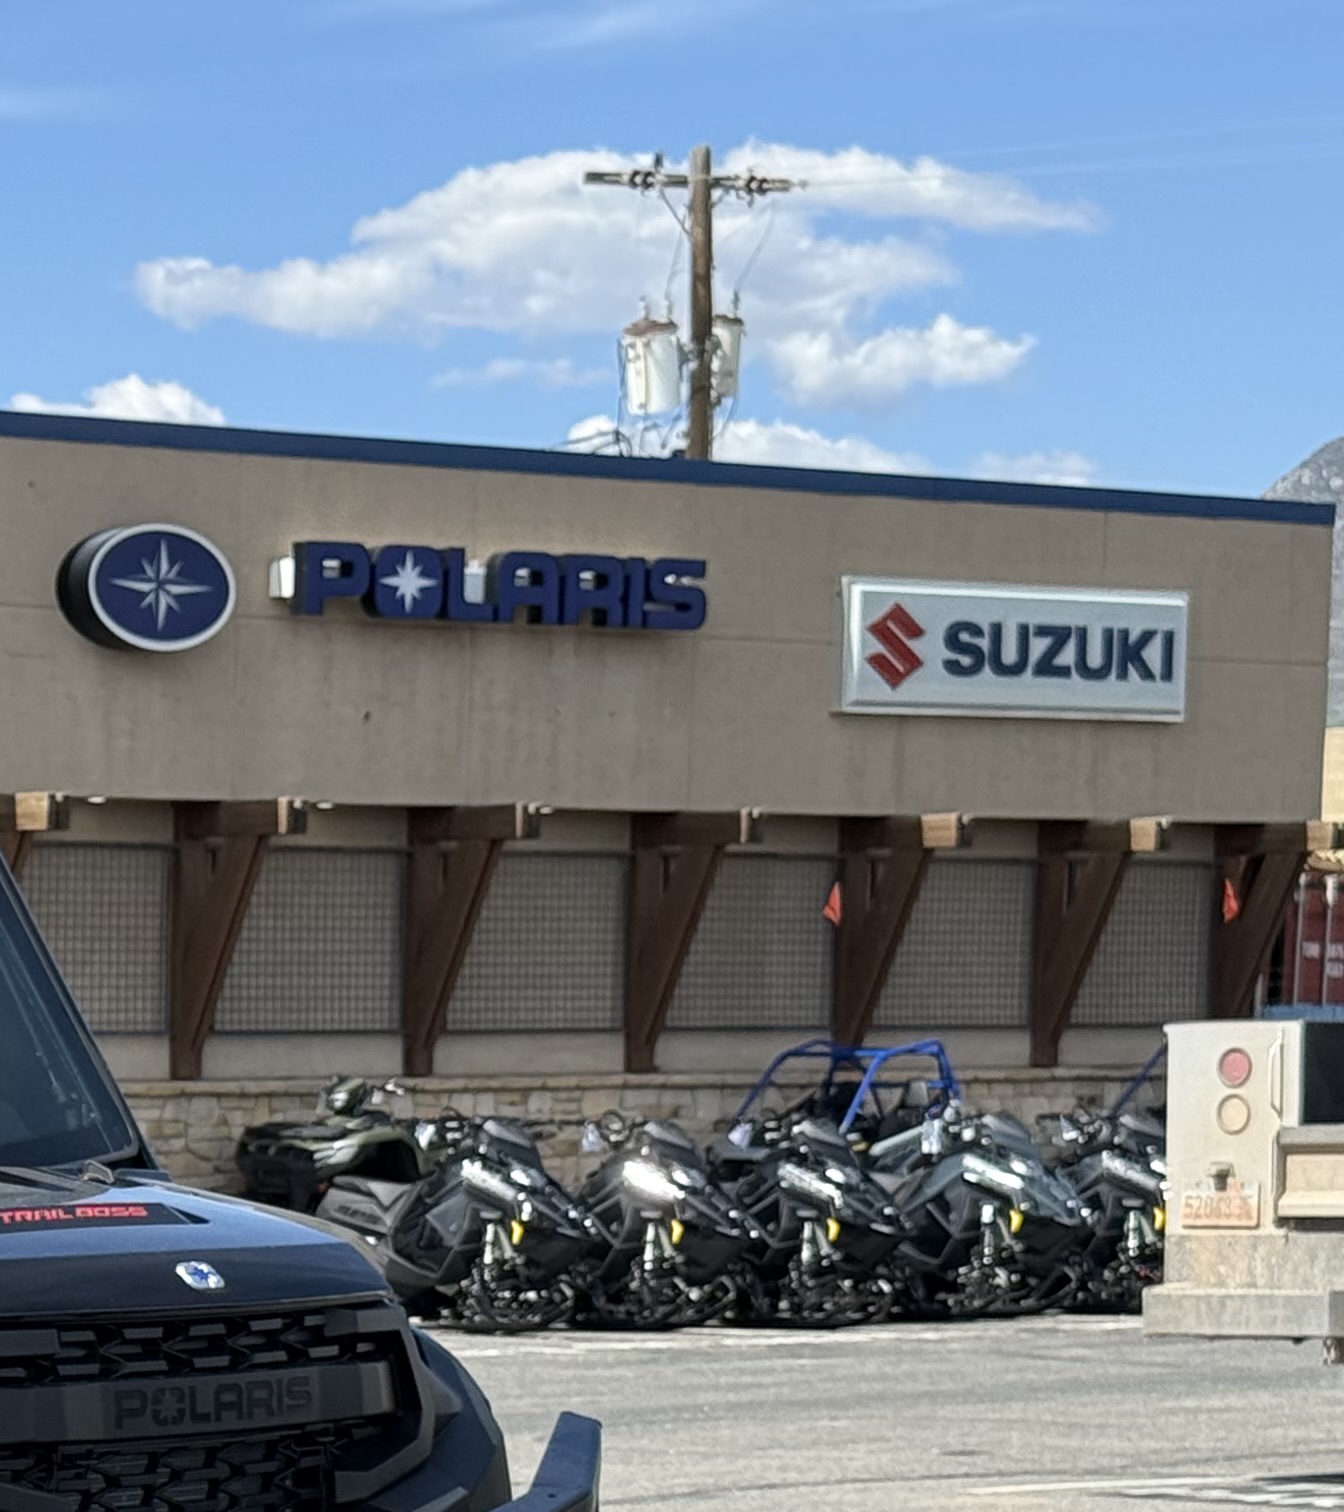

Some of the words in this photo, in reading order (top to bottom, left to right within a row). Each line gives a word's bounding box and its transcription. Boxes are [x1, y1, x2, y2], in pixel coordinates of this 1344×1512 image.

[292, 541, 707, 630] POLARIS
[941, 620, 1175, 683] SUZUKI
[75, 1206, 149, 1218] BOSS
[114, 1375, 312, 1430] POLARIS
